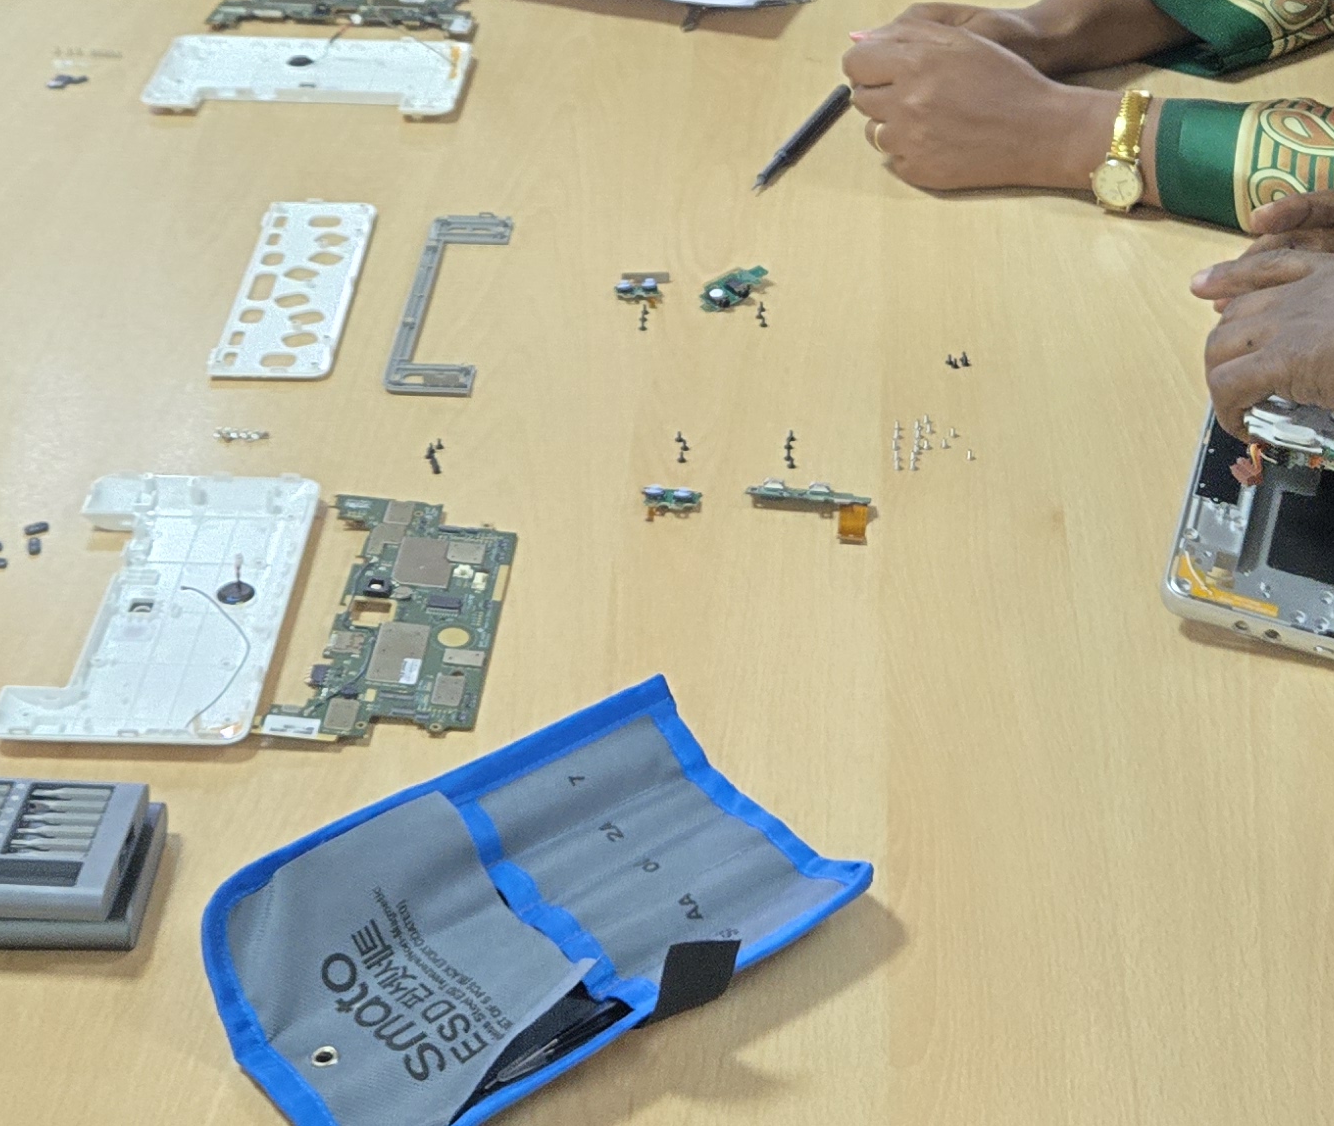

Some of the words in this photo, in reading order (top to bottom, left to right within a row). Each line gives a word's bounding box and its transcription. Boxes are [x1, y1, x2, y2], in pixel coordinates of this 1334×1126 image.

[678, 893, 704, 920] AA
[321, 952, 446, 1082] Smato
[421, 1000, 489, 1064] ESD
